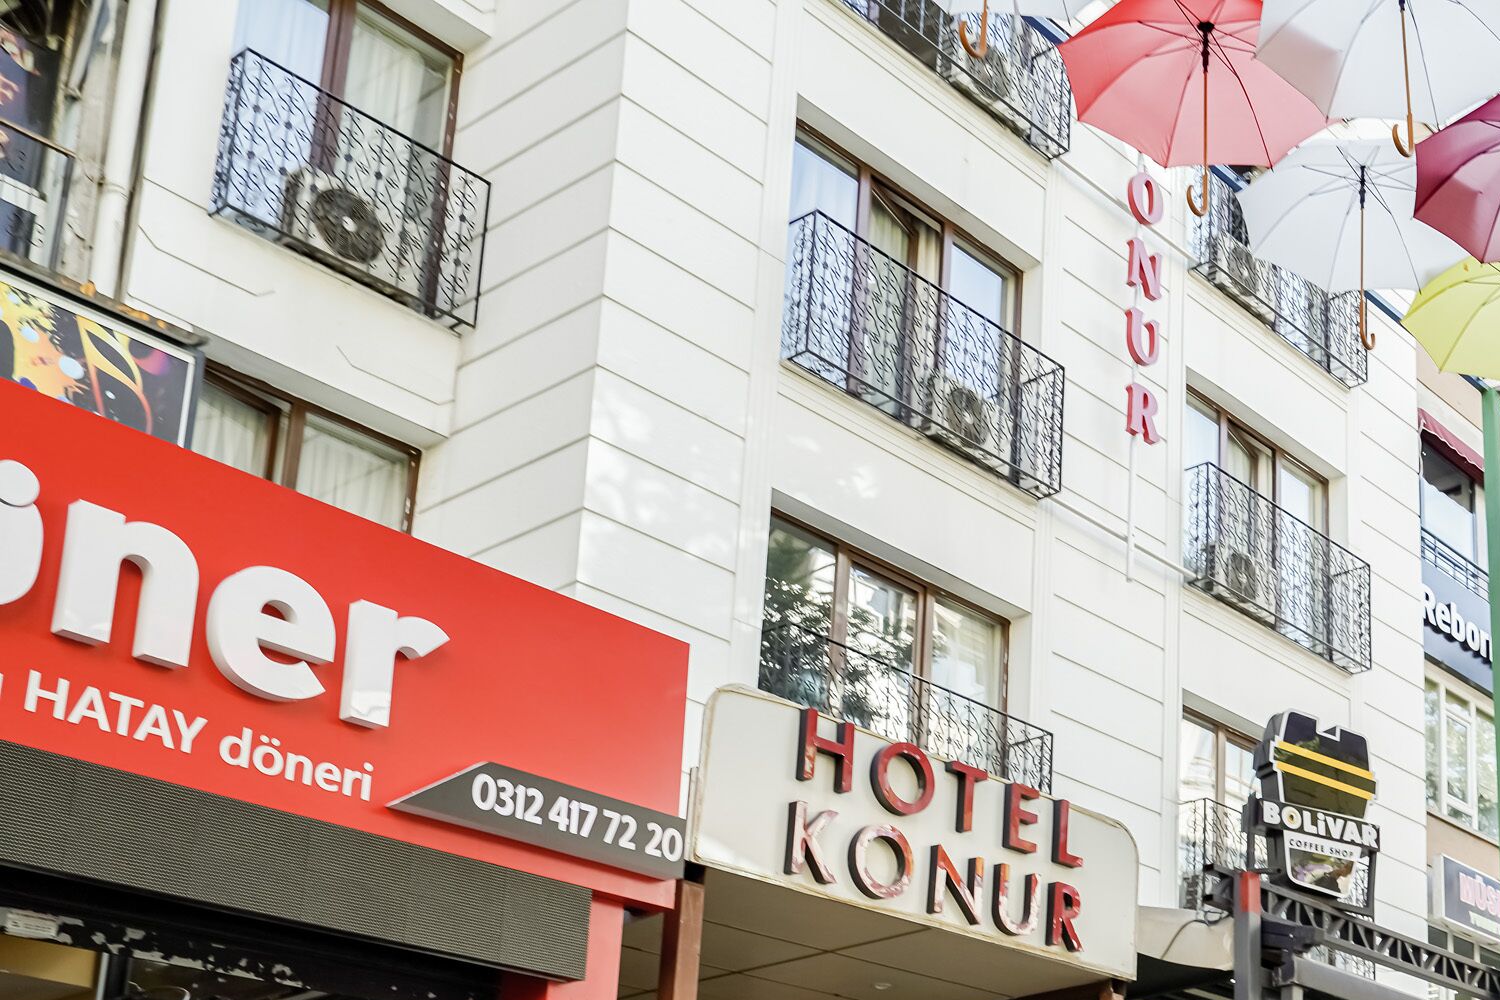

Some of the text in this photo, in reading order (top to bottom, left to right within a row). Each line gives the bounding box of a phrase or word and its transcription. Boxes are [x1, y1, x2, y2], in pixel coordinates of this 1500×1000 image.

[24, 669, 374, 801] HATAY döneri
[795, 708, 1083, 868] HOTEL
[471, 771, 684, 863] 0312 417 72 20
[784, 800, 1083, 952] KONUR
[1289, 838, 1354, 858] COFFEE SHOP
